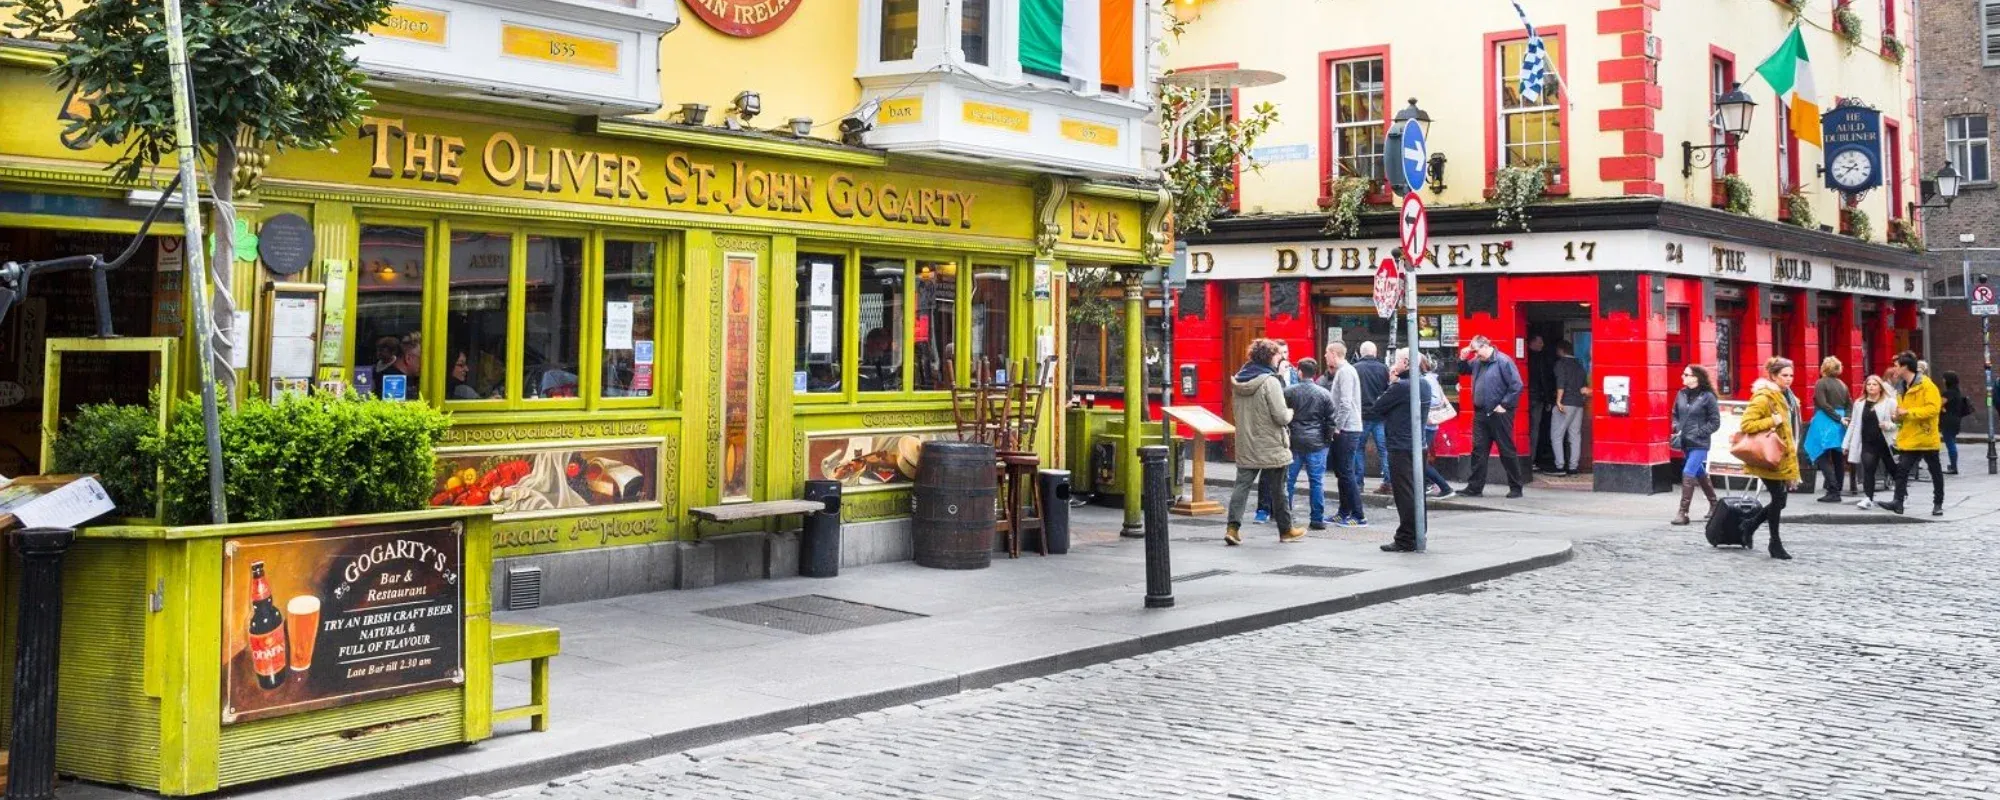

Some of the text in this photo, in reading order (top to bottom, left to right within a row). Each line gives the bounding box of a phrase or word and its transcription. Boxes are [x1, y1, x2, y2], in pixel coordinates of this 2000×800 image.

[549, 40, 577, 57] 1835
[888, 104, 912, 118] bar
[1836, 123, 1865, 132] AULD
[1825, 132, 1877, 143] DUBLINER
[359, 115, 466, 185] THE
[481, 131, 649, 199] OLIVER
[826, 171, 978, 230] GOGARTY
[1070, 199, 1126, 244] BAR
[1564, 241, 1597, 261] 17
[1664, 242, 1685, 264] 24
[1711, 246, 1747, 273] THE
[1774, 254, 1812, 283] AULD
[1833, 265, 1890, 292] DUBLINER
[618, 421, 649, 435] late
[344, 539, 447, 583] GOGARTY'S
[380, 569, 413, 585] Bar &
[367, 585, 427, 602] Restaurant
[324, 604, 453, 631] TRY AN IRISH CRAFT BEER
[359, 622, 416, 640] NATURAL &
[338, 634, 431, 657] FULL OF FLAVOUR
[346, 657, 432, 678] Late Bar till 2.30 am
